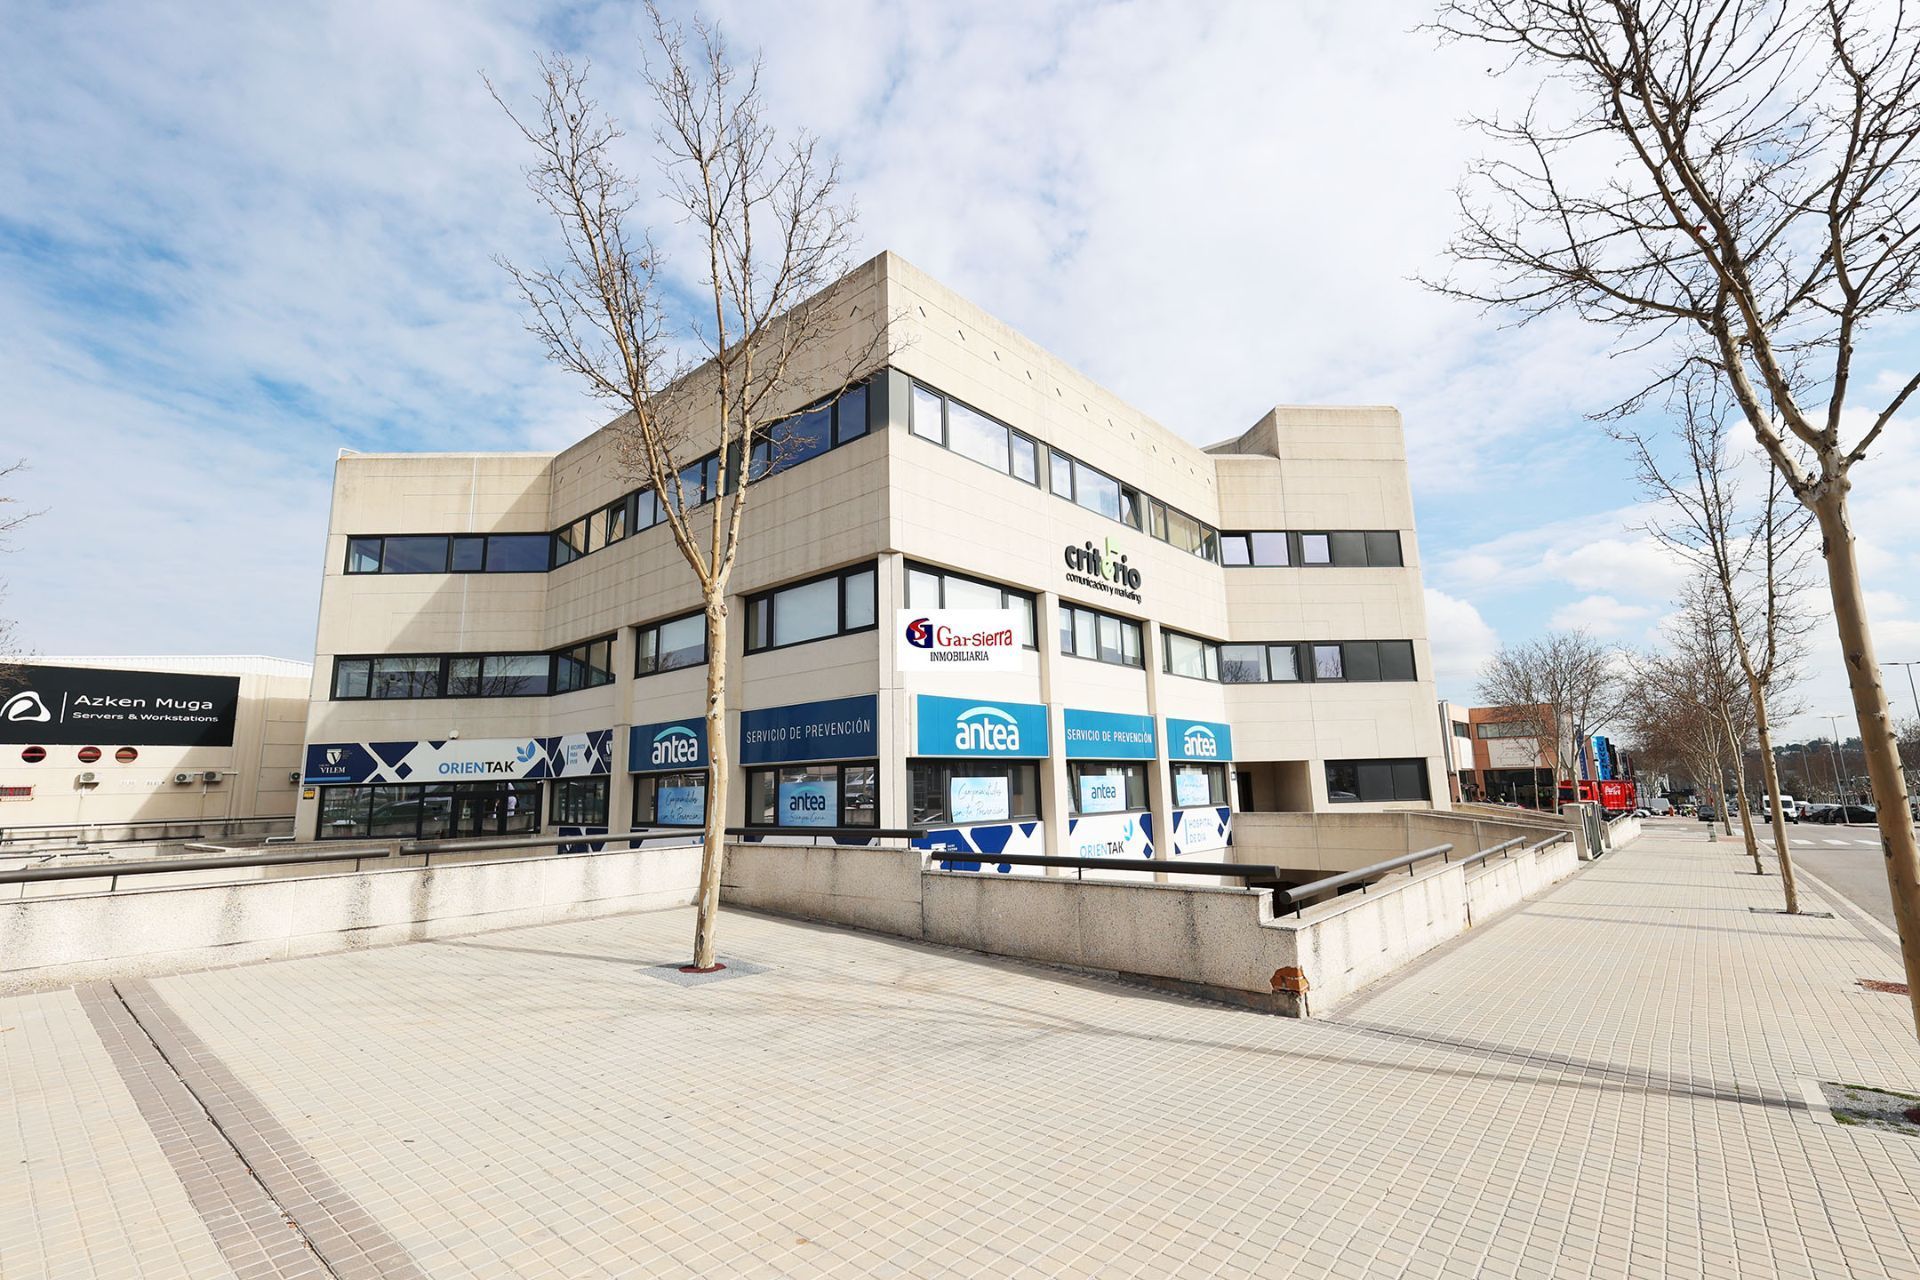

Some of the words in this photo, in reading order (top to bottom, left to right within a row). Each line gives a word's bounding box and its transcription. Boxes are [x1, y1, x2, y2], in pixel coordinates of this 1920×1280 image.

[1114, 588, 1142, 605] marketing
[930, 651, 989, 662] INMOBILIARIA
[73, 694, 147, 709] Azken
[155, 698, 214, 711] Muga
[72, 711, 124, 721] Servers
[128, 713, 138, 721] &
[140, 713, 219, 723] Workstations
[746, 727, 786, 744] SERVICIO
[790, 726, 801, 740] DE
[805, 717, 871, 738] PREVENCIÓN
[955, 717, 1020, 751] antea
[1067, 728, 1100, 741] SERVICIO
[1102, 731, 1111, 741] DE
[1113, 729, 1152, 744] PREVENCIÓN
[652, 735, 698, 764] antea
[1184, 732, 1217, 757] antea
[320, 766, 346, 774] VILEM
[439, 761, 515, 774] ORIENTAK
[1091, 784, 1117, 799] antea
[789, 792, 826, 811] antea
[1080, 840, 1125, 858] ORIENTAK
